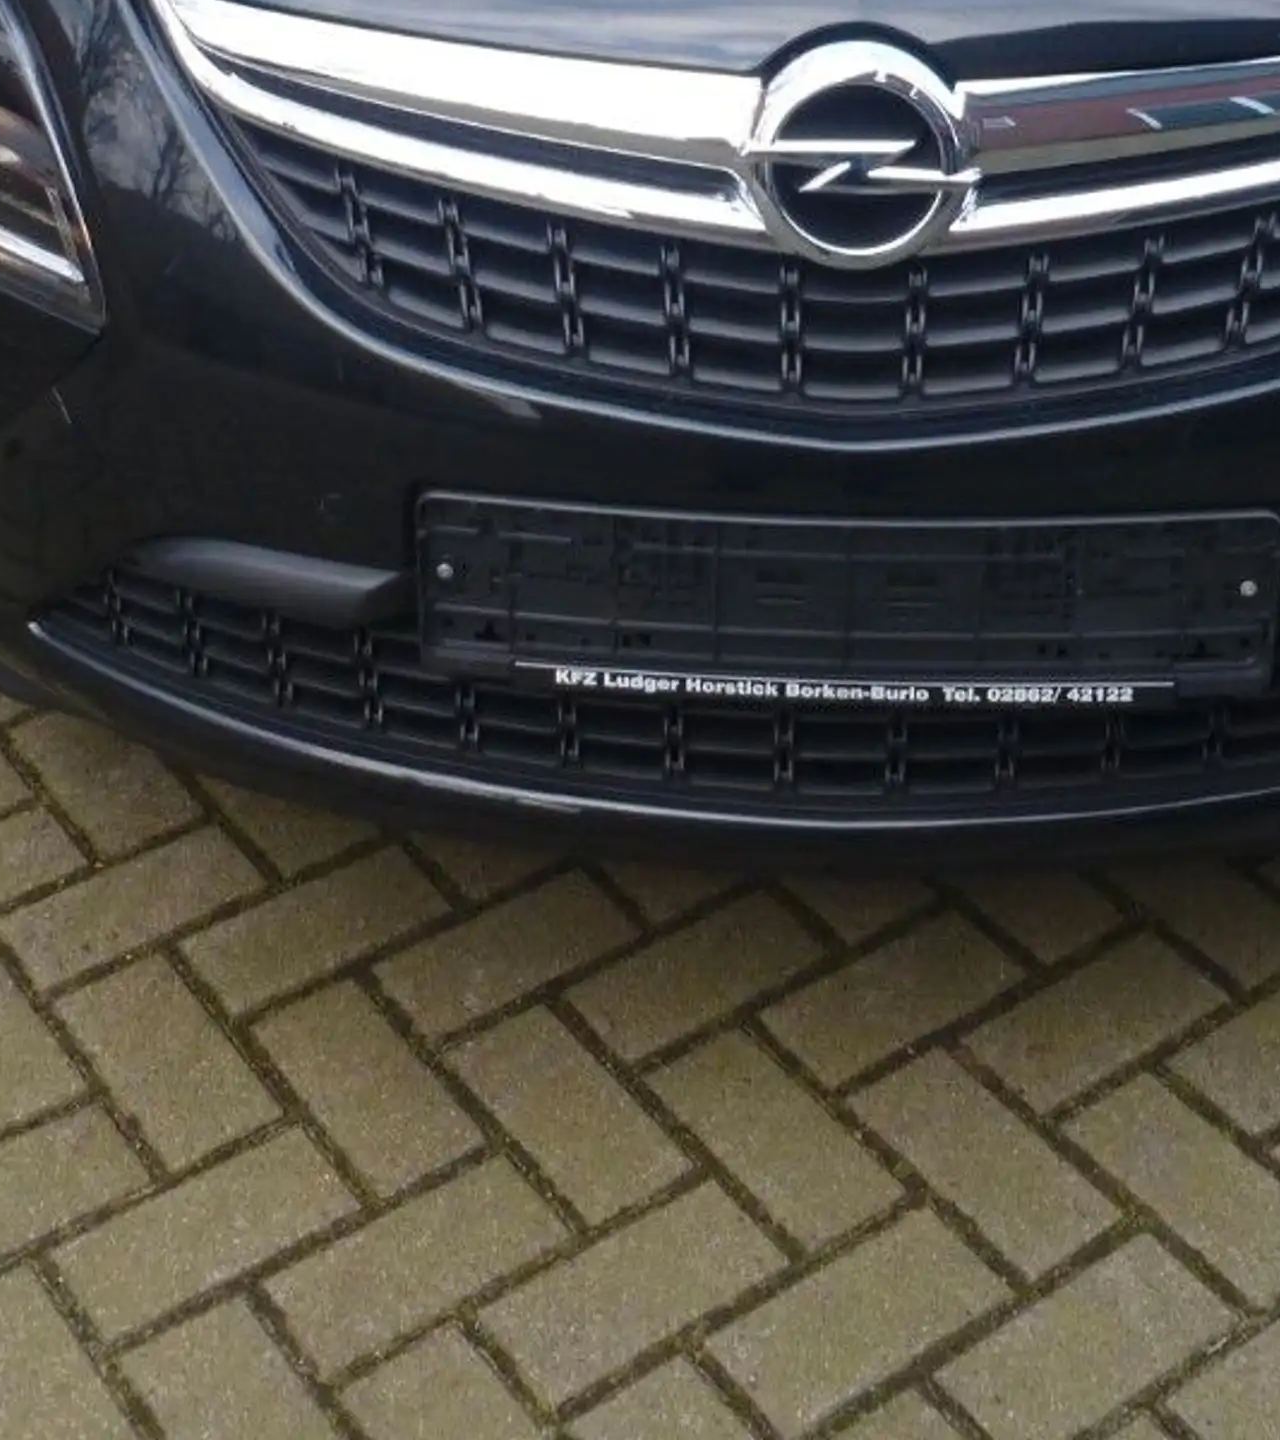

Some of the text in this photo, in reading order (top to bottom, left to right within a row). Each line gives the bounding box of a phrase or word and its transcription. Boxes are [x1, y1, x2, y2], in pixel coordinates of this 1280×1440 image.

[555, 668, 597, 686] KFZ
[603, 672, 680, 693] Ludger
[685, 676, 779, 697] Horstick
[785, 681, 930, 702] Borken-Burlo
[942, 686, 981, 703] Tel.
[1066, 686, 1134, 703] 42122
